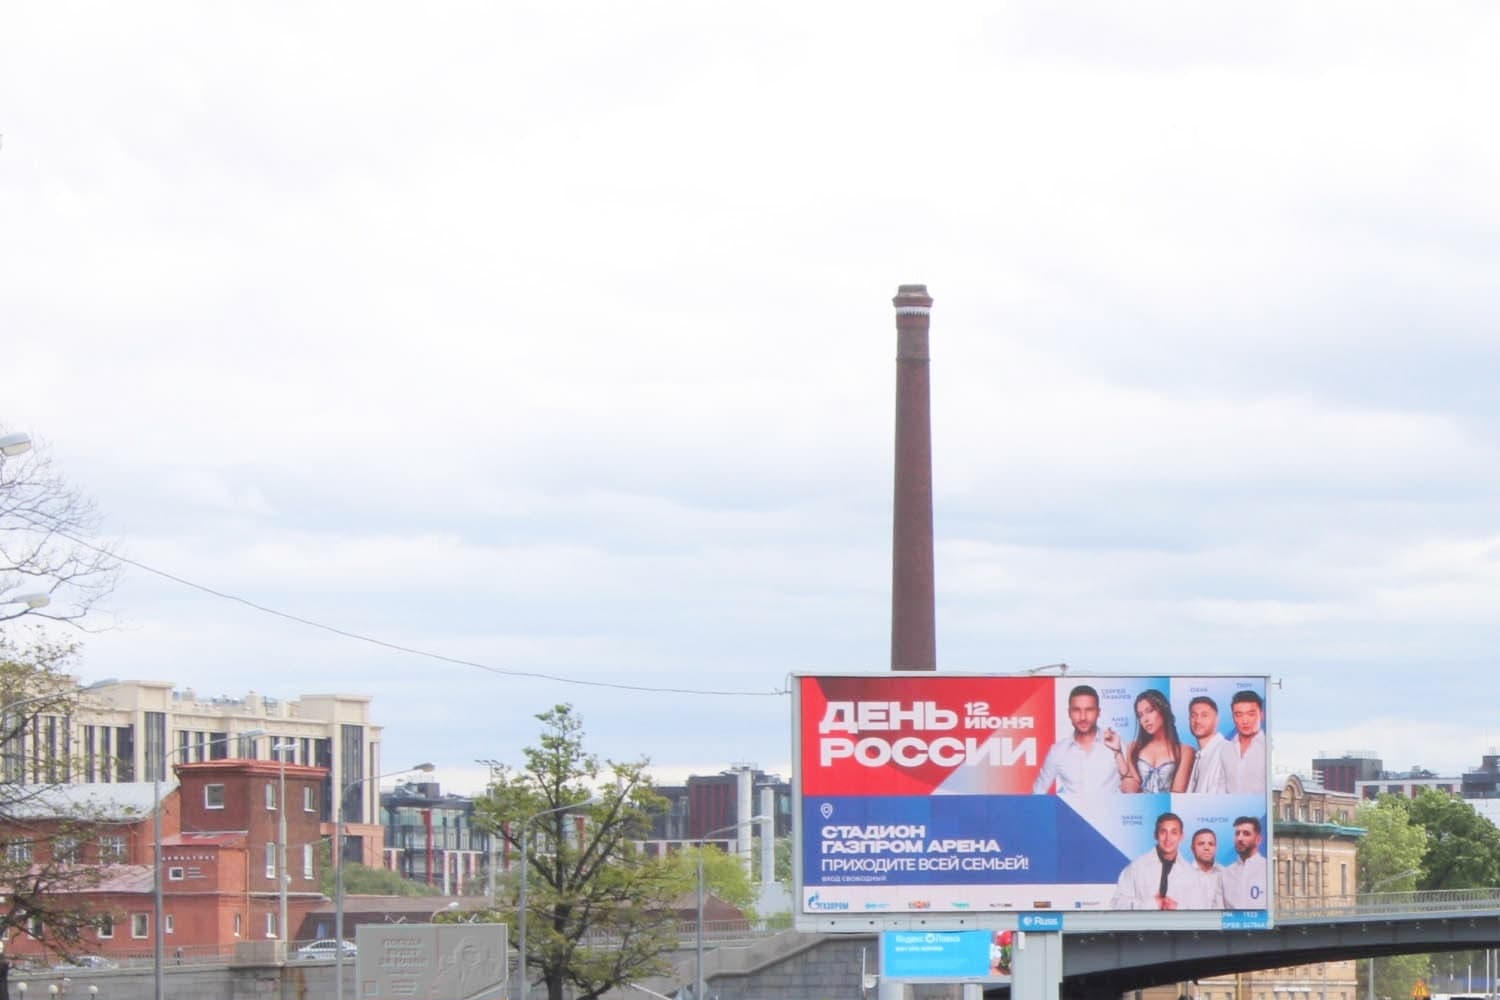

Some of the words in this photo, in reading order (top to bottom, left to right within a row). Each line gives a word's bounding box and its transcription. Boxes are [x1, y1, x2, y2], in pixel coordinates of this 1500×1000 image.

[964, 702, 990, 716] 12
[819, 701, 958, 734] ДЕНЬ
[964, 717, 1035, 729] ИЮНЯ
[820, 737, 1037, 767] РОССИИ
[821, 825, 925, 840] СТАДИОН
[822, 840, 923, 854] ГАЗПРОМ
[927, 839, 1001, 853] АРЕНА
[822, 858, 916, 873] ПРИХОДИТЕ
[918, 855, 960, 870] ВСЕЙ
[962, 855, 1029, 870] СЕМЬЕЙ!
[1034, 916, 1058, 926] Russ
